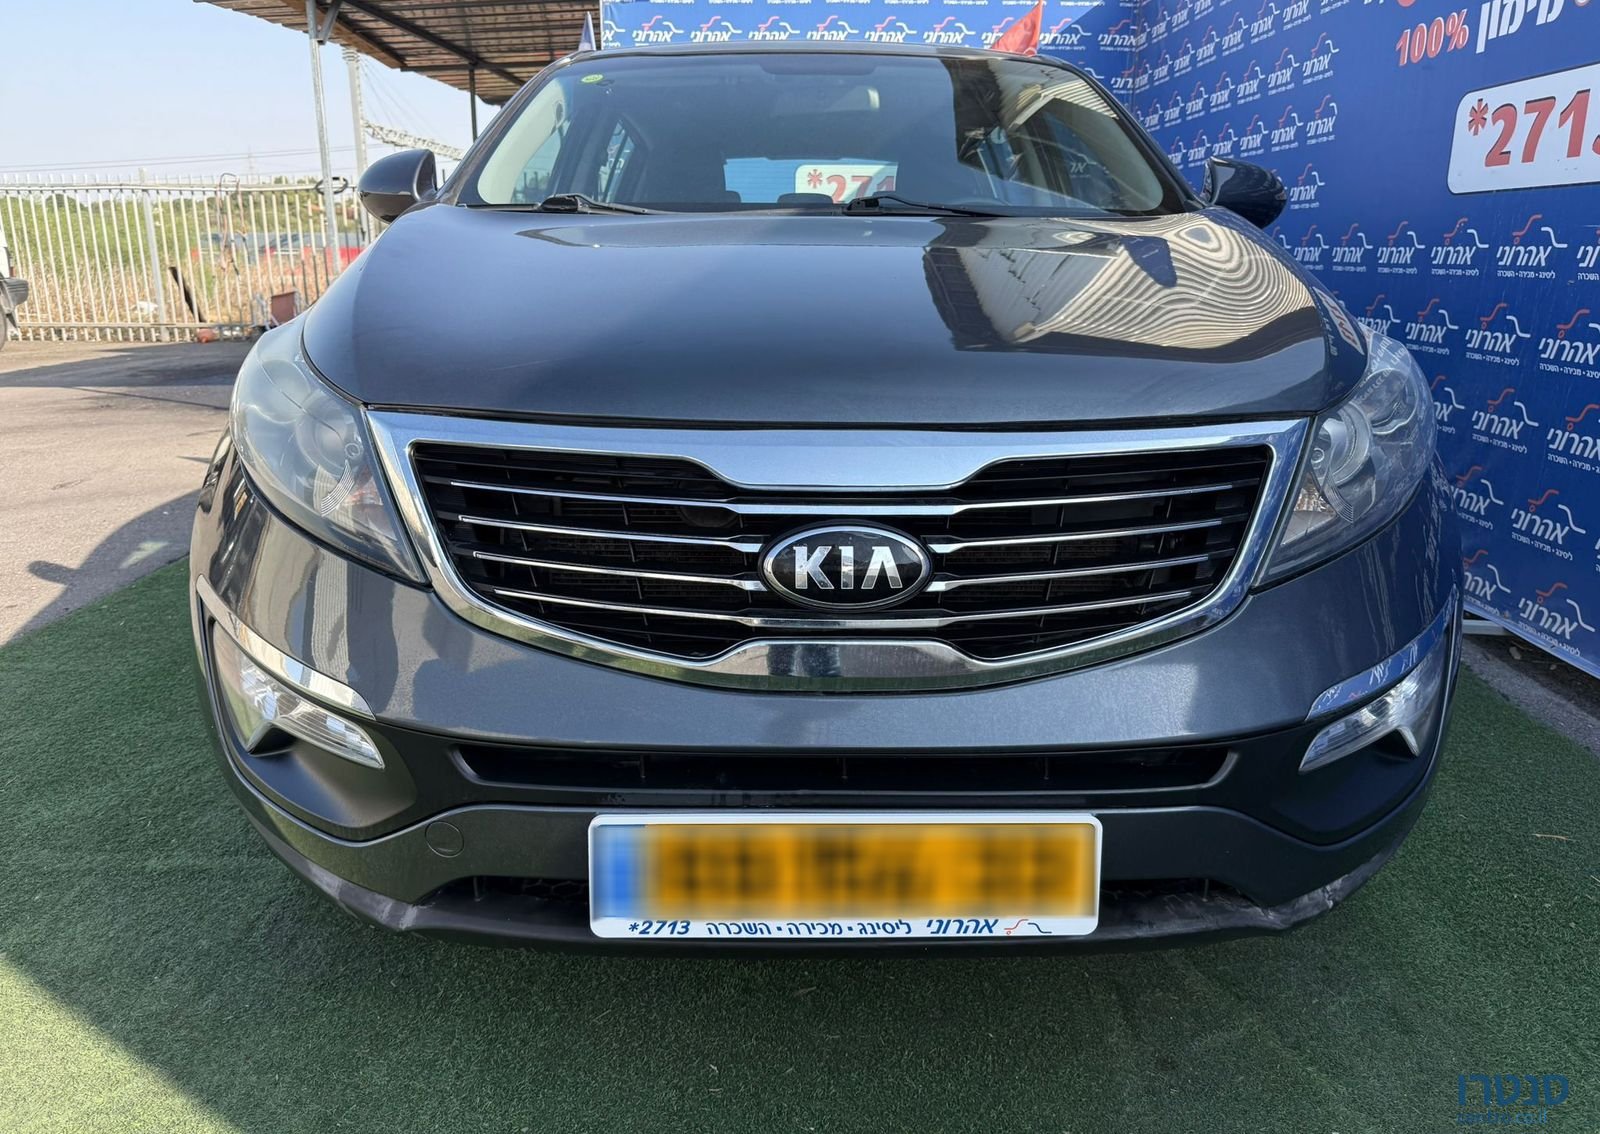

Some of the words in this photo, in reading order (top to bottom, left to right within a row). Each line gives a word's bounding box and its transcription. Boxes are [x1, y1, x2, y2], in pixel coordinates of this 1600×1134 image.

[1396, 8, 1469, 67] 100%
[1465, 88, 1600, 167] 271
[1377, 247, 1415, 264] אהרוני
[1431, 246, 1476, 265] אהרוני
[1496, 246, 1552, 267] אהרוני
[1405, 322, 1447, 344] אהרוני
[1465, 329, 1516, 353] אהרוני
[1538, 338, 1600, 365] אהרוני
[1471, 410, 1524, 440] אהרוני
[1511, 508, 1570, 545] אהרוני
[793, 546, 903, 590] KIA
[1518, 597, 1578, 640] אהרוני
[705, 921, 772, 936] השכרה
[787, 922, 843, 936] מכירה
[858, 918, 912, 935] ליסינג
[925, 918, 1000, 935] אהרוני
